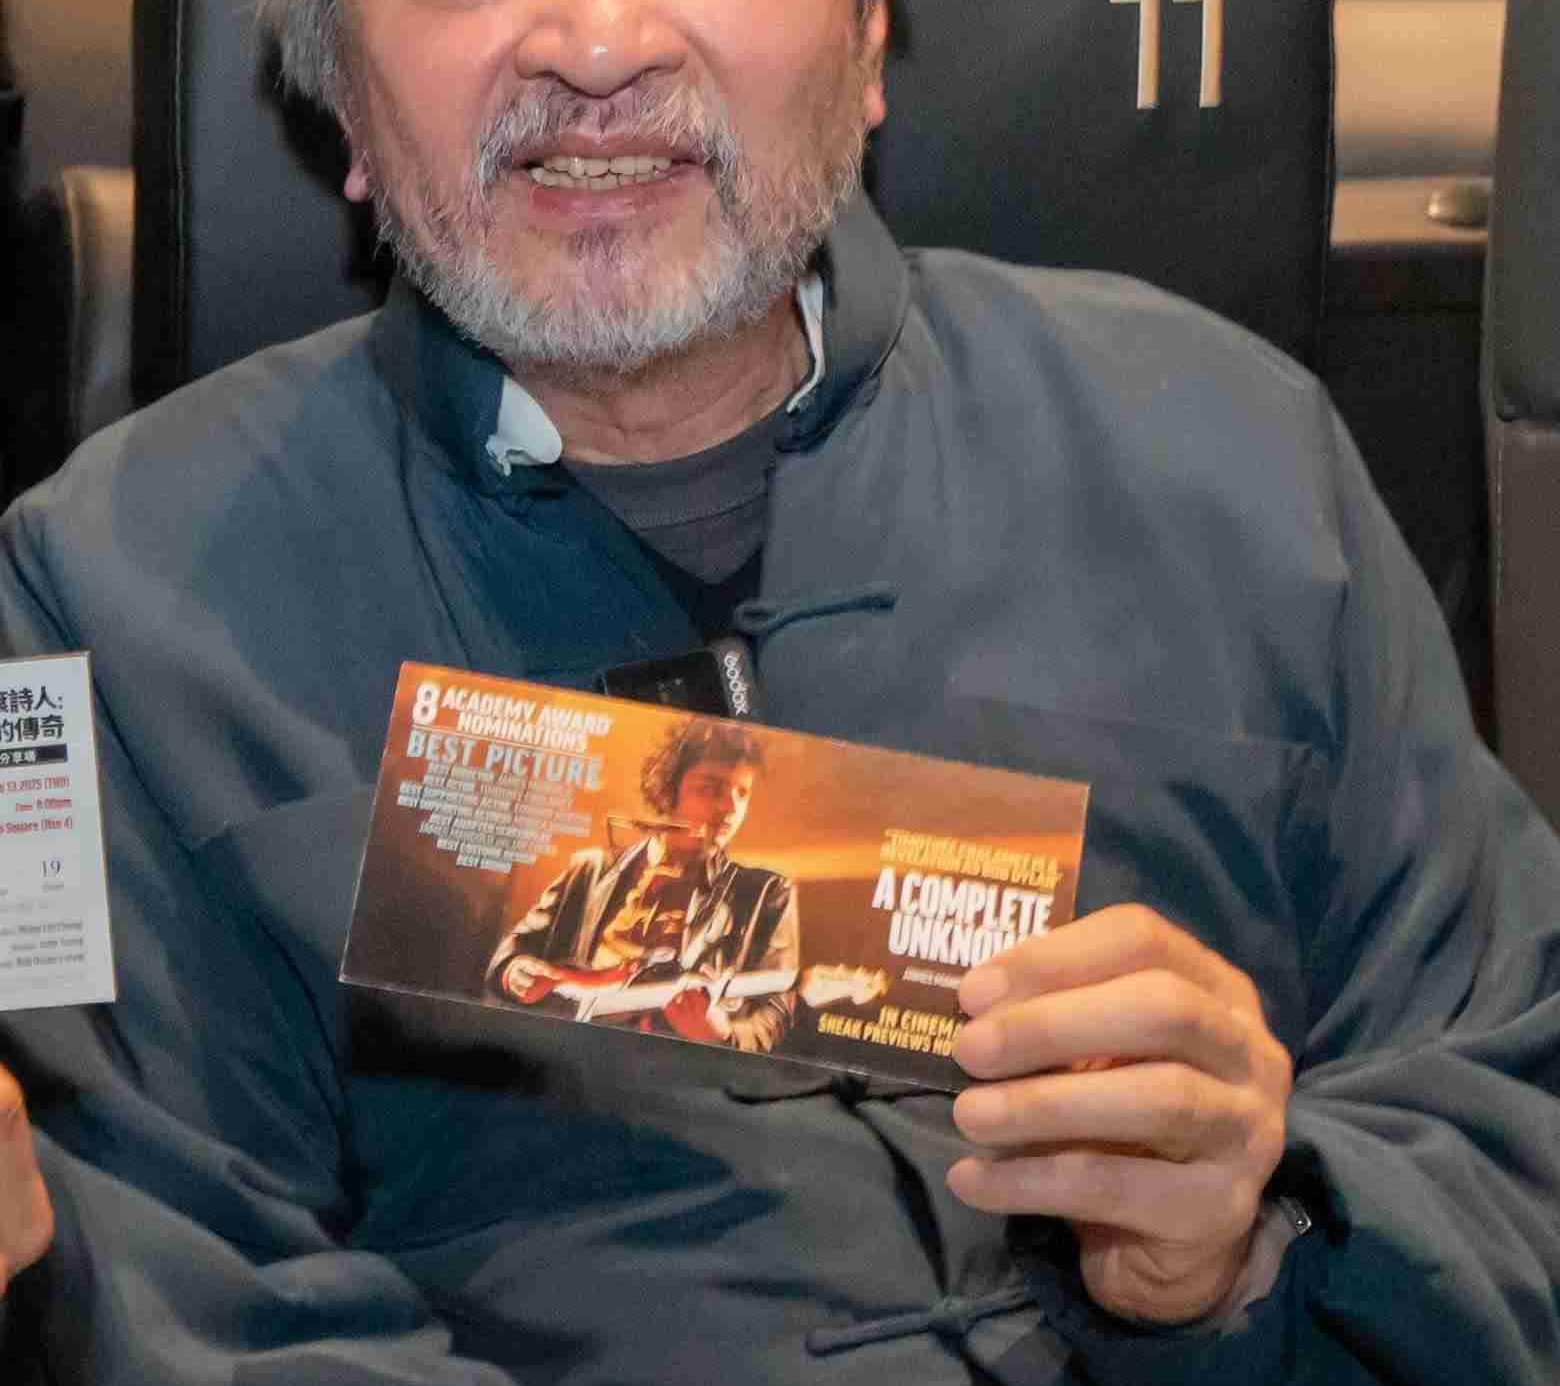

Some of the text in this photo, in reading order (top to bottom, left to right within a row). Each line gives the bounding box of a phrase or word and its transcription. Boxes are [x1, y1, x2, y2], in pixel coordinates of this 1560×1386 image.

[412, 683, 440, 725] 8
[441, 688, 537, 721] ACADEMY
[457, 711, 589, 753] NOMINATIONS
[406, 728, 477, 767] BEST
[485, 743, 605, 791] PICTURE
[871, 868, 1054, 936] A COMPLETE
[817, 1012, 861, 1041] SNEAK
[862, 1021, 931, 1053] PREVIEWS
[879, 1004, 899, 1028] IN
